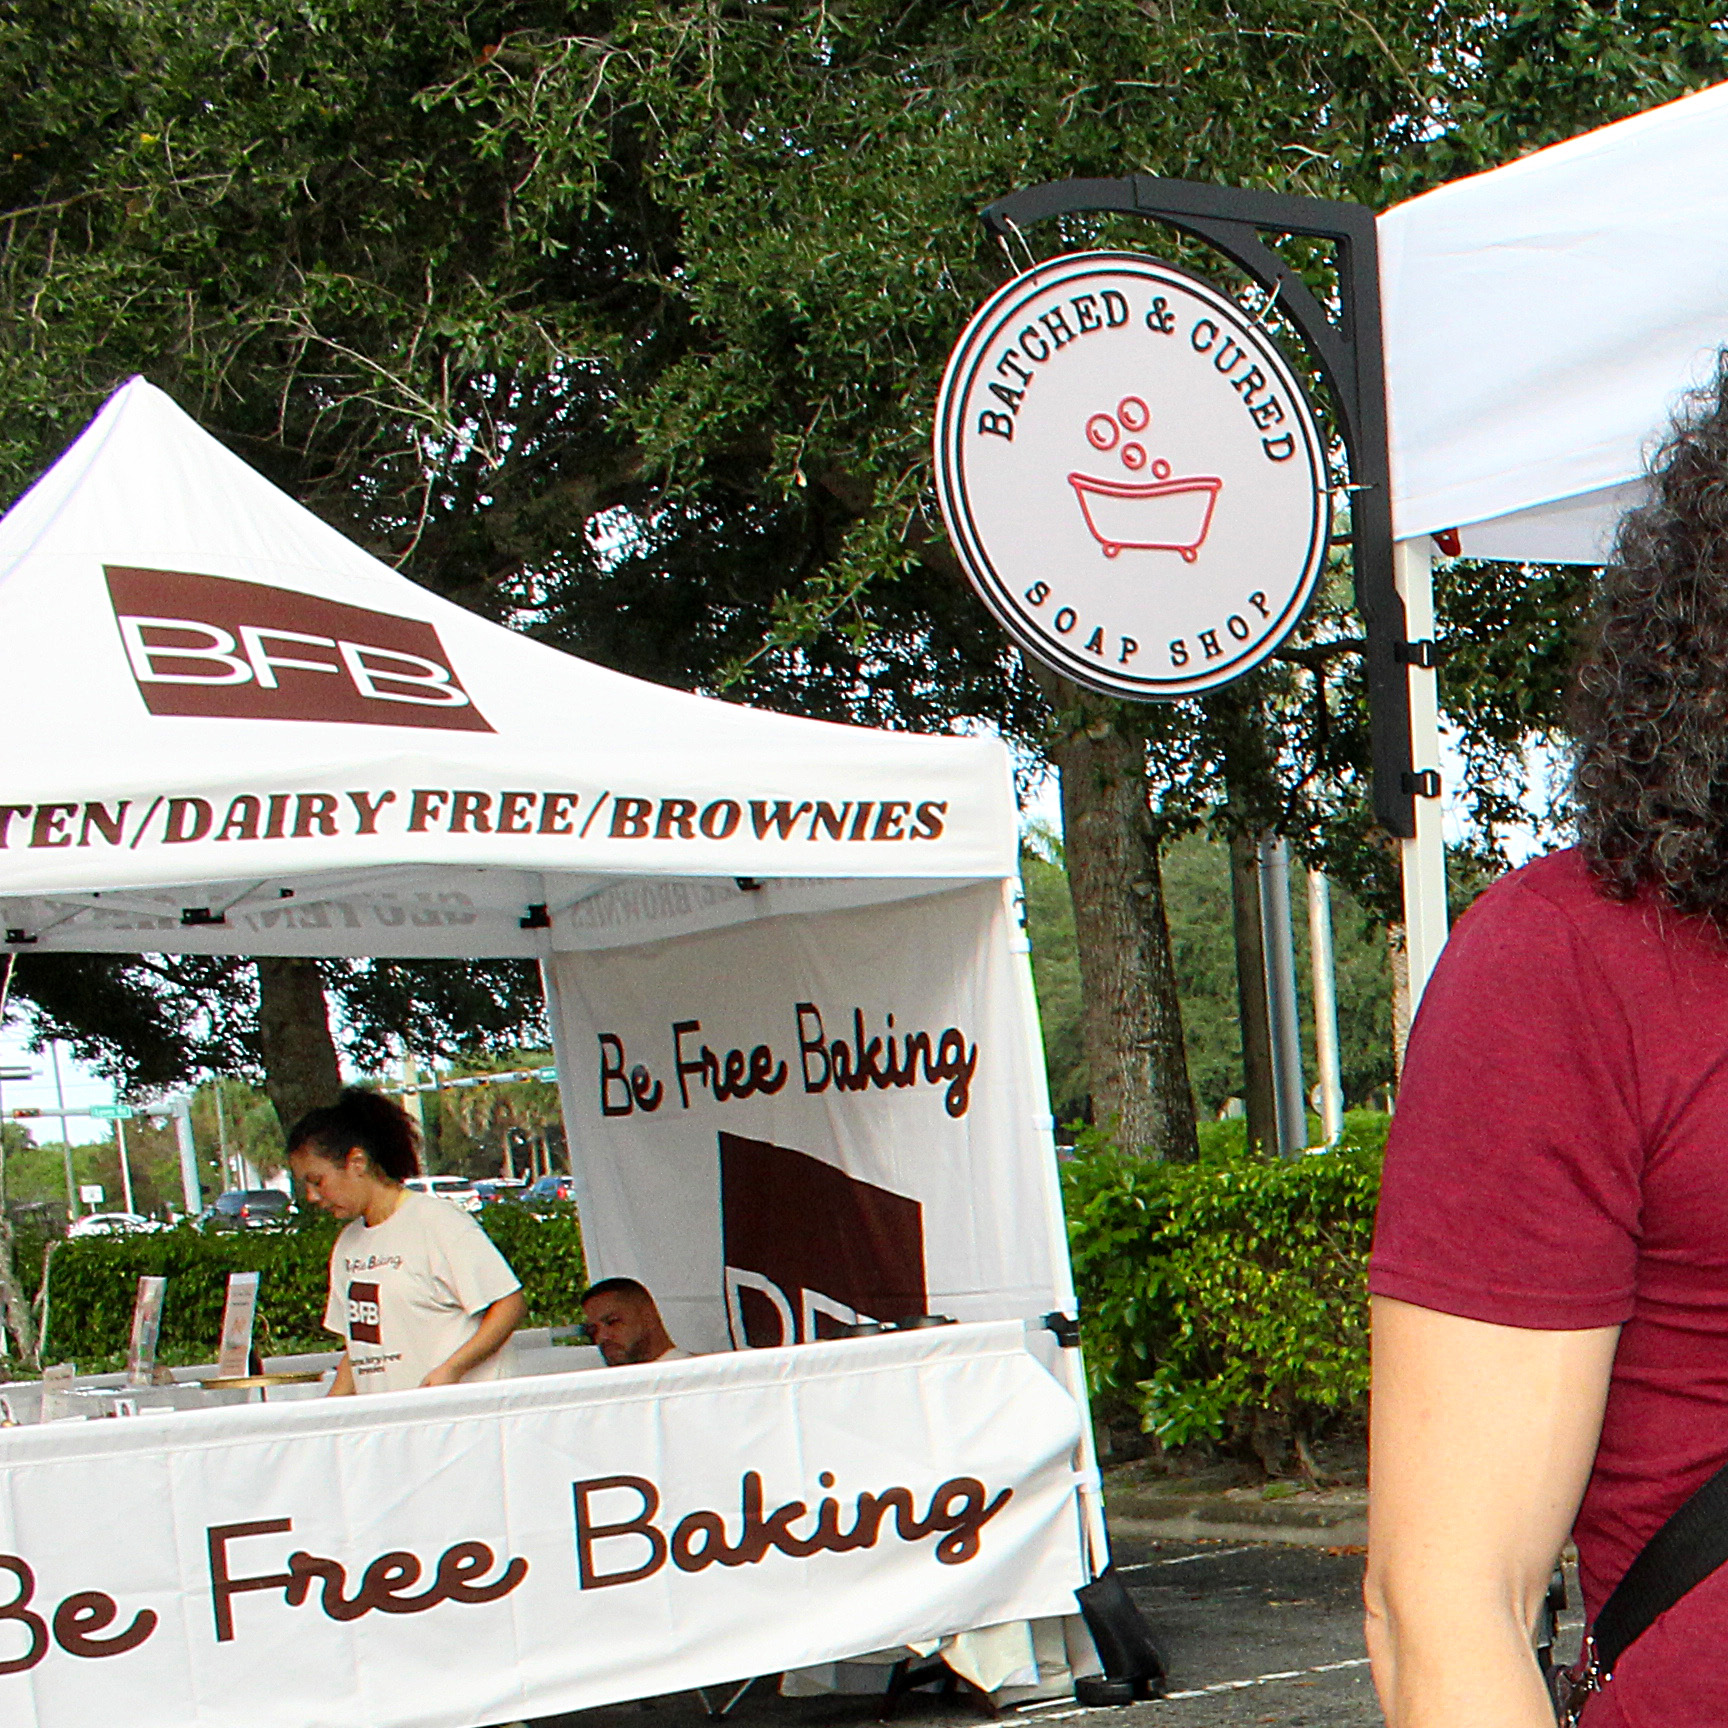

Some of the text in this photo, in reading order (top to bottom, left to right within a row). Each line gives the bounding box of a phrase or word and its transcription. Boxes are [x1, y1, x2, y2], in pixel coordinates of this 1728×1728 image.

[979, 290, 1295, 462] BATCHED & CURED
[119, 615, 472, 707] BFB
[1024, 580, 1273, 667] SOAP SHOP
[408, 790, 947, 840] FREE/BROWNIES
[598, 1002, 976, 1117] Be Free Baking
[207, 1518, 528, 1642] Free
[573, 1471, 1013, 1590] Baking
